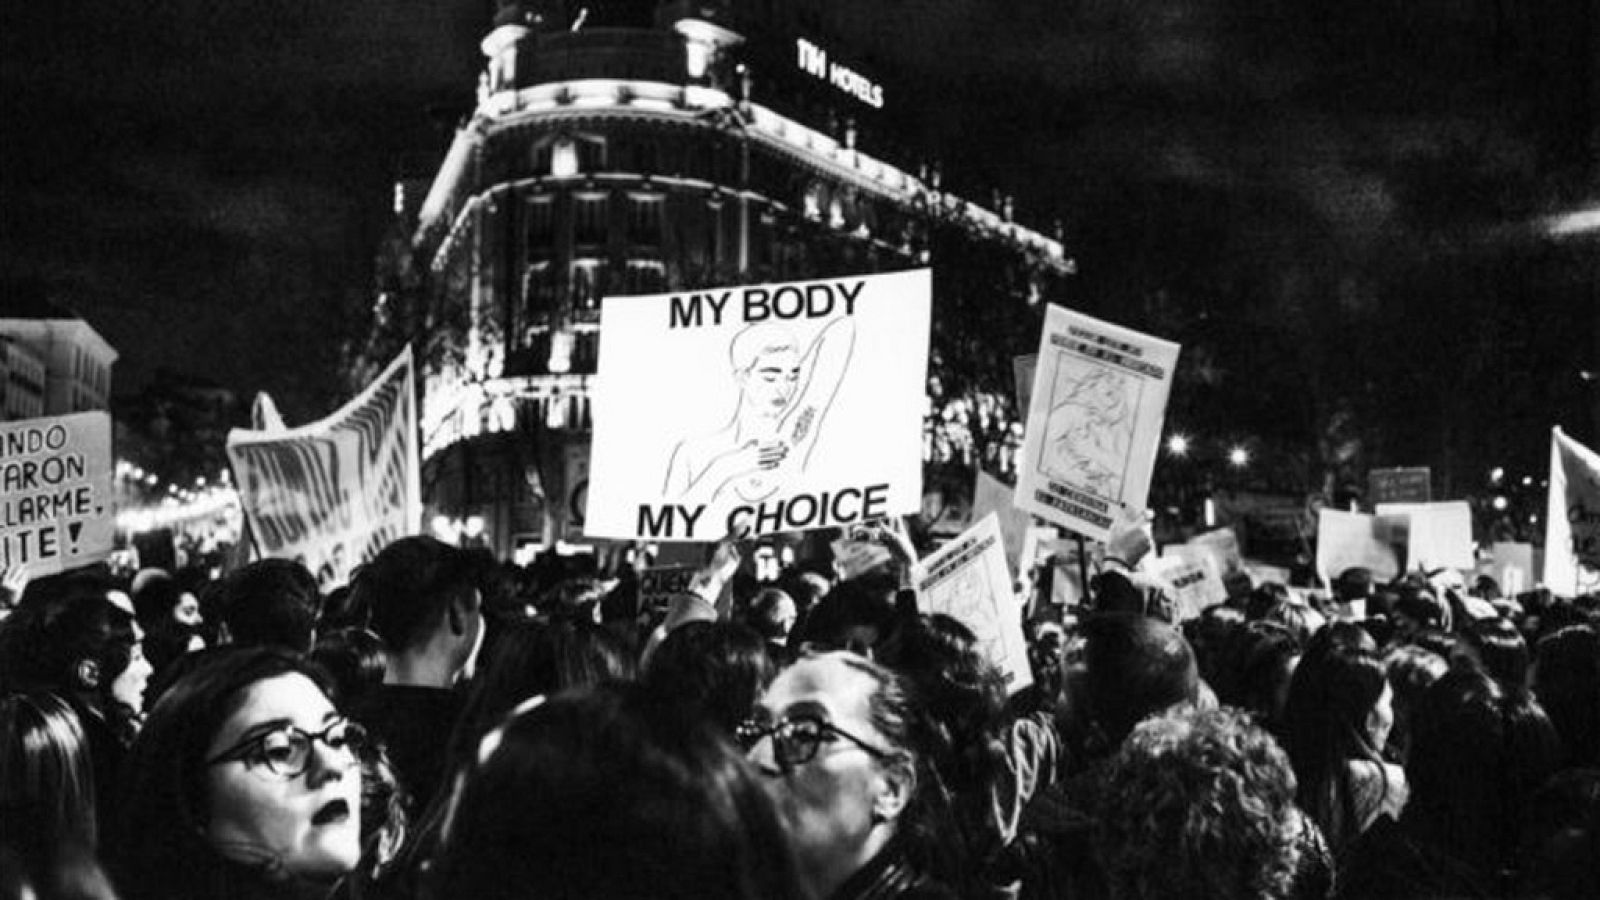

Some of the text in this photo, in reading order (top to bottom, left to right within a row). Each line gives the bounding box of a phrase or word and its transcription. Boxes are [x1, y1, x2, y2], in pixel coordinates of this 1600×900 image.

[829, 61, 884, 108] HOTELS
[669, 281, 866, 329] MY BODY
[0, 424, 66, 457] NDO
[0, 455, 84, 492] ARON
[636, 483, 889, 540] MY CHOICE
